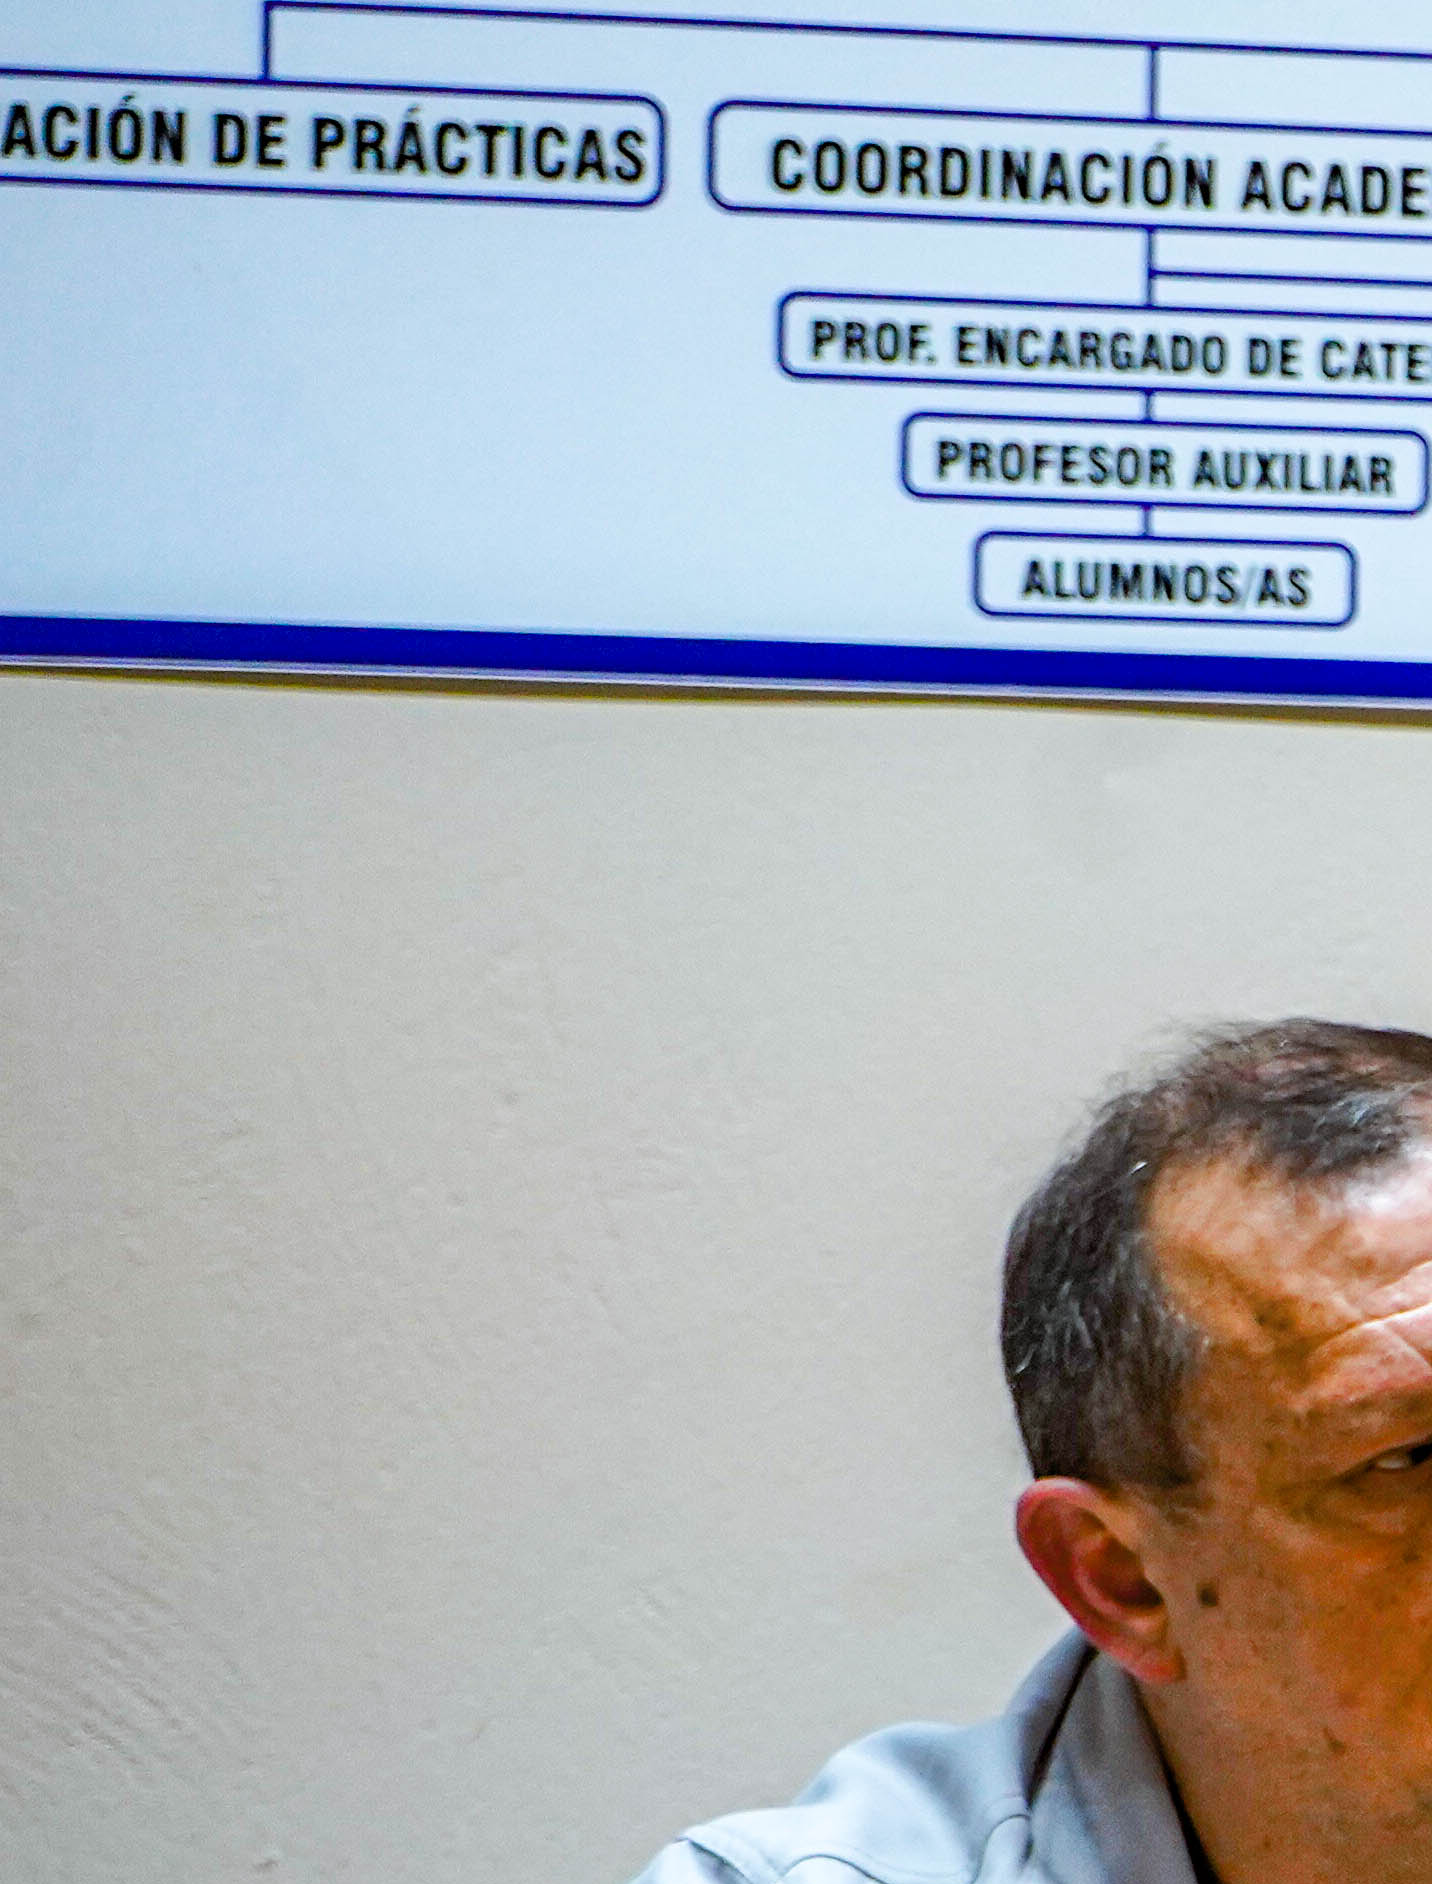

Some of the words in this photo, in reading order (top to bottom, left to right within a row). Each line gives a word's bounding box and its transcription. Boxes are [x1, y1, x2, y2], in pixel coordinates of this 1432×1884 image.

[0, 93, 187, 166] ACIÓN
[212, 112, 286, 169] DE
[311, 107, 646, 185] PRÁCTICAS
[770, 137, 1215, 210] COORDINACIÓN
[811, 318, 936, 364] PROF.
[955, 324, 1227, 376] ENCARGADO
[1247, 336, 1299, 378] DE
[937, 439, 1173, 487] PROFESOR
[1192, 449, 1394, 495] AUXILIAR
[1021, 559, 1313, 608] ALUMNOS/AS
